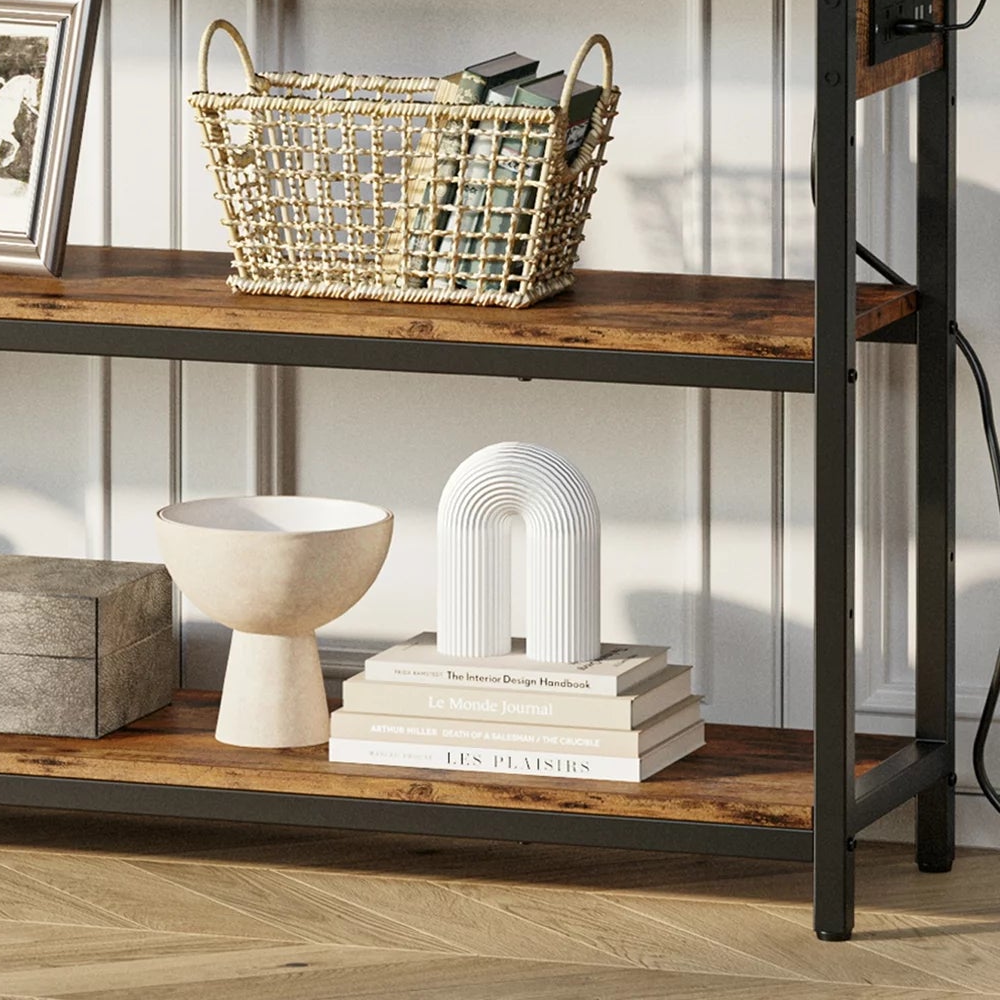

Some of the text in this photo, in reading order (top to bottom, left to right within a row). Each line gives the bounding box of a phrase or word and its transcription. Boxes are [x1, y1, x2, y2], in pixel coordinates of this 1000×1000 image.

[447, 670, 464, 681] The
[466, 672, 501, 684] Interior
[503, 674, 537, 687] Design
[540, 677, 590, 689] Handbook
[428, 695, 553, 716] Le Monde Journal
[447, 751, 482, 766] LES
[493, 755, 591, 773] PLAISIRS
